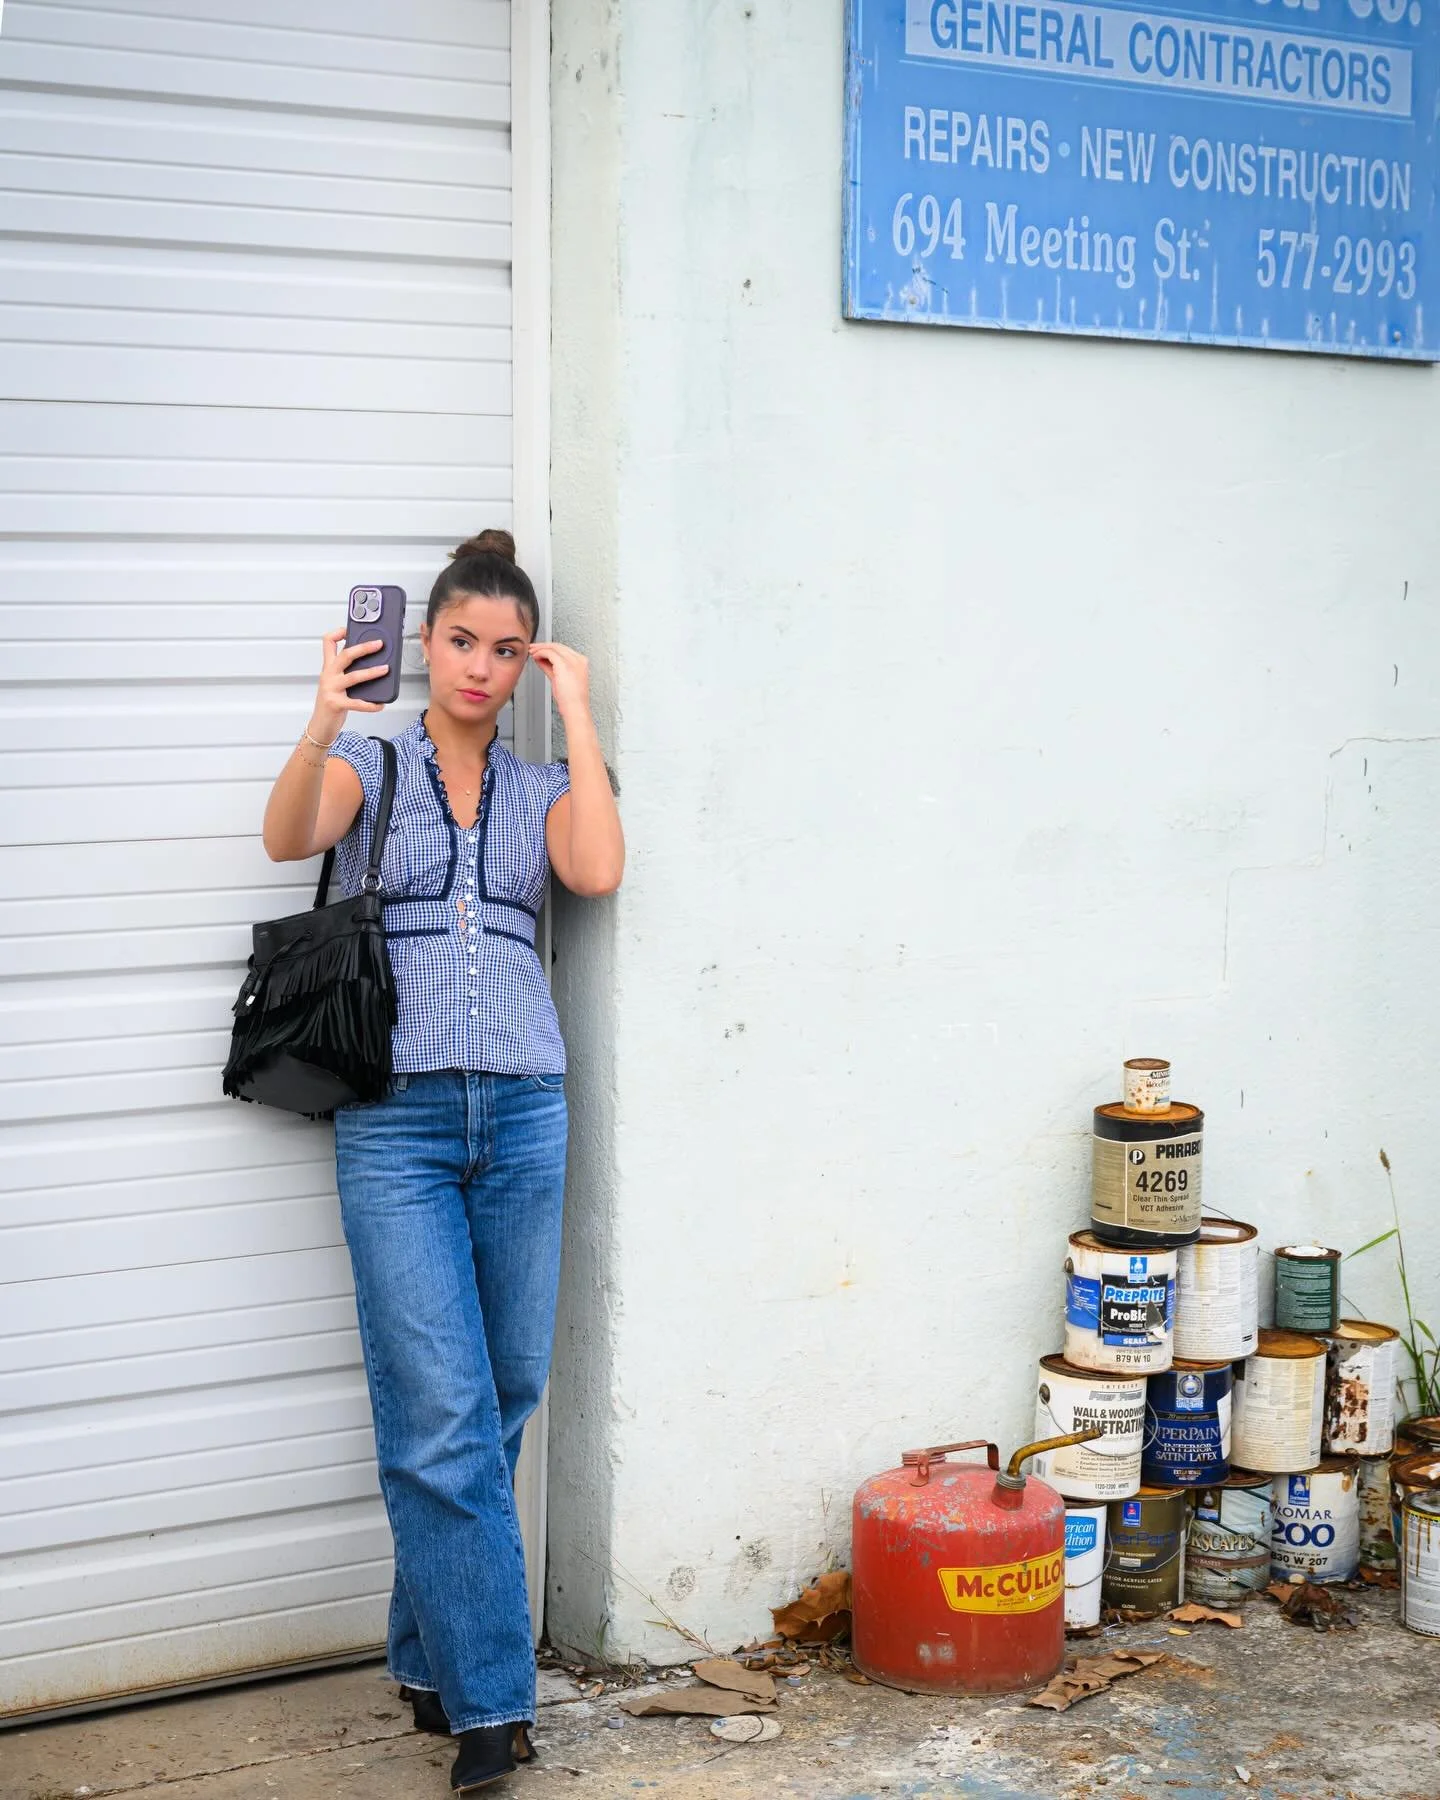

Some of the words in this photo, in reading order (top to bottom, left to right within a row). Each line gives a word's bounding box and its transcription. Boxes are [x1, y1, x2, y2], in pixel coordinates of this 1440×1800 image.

[930, 0, 1114, 69] GENERAL
[1129, 22, 1391, 105] CONTRACTORS
[904, 106, 1050, 173] REPAIRS
[1081, 126, 1156, 184] NEW
[1168, 135, 1411, 211] CONSTRUCTION
[893, 193, 966, 259] 694
[985, 202, 1136, 289] Meeting
[1136, 1169, 1188, 1192] 4269
[1134, 1354, 1142, 1363] W
[1073, 1406, 1099, 1418] WALL
[1100, 1409, 1107, 1418] &
[1155, 1451, 1187, 1461] SATIN
[1189, 1451, 1218, 1462] LATEX
[1272, 1519, 1335, 1548] 200
[1293, 1556, 1304, 1565] W
[1308, 1557, 1328, 1566] 207
[957, 1558, 1064, 1598] McCULLO
